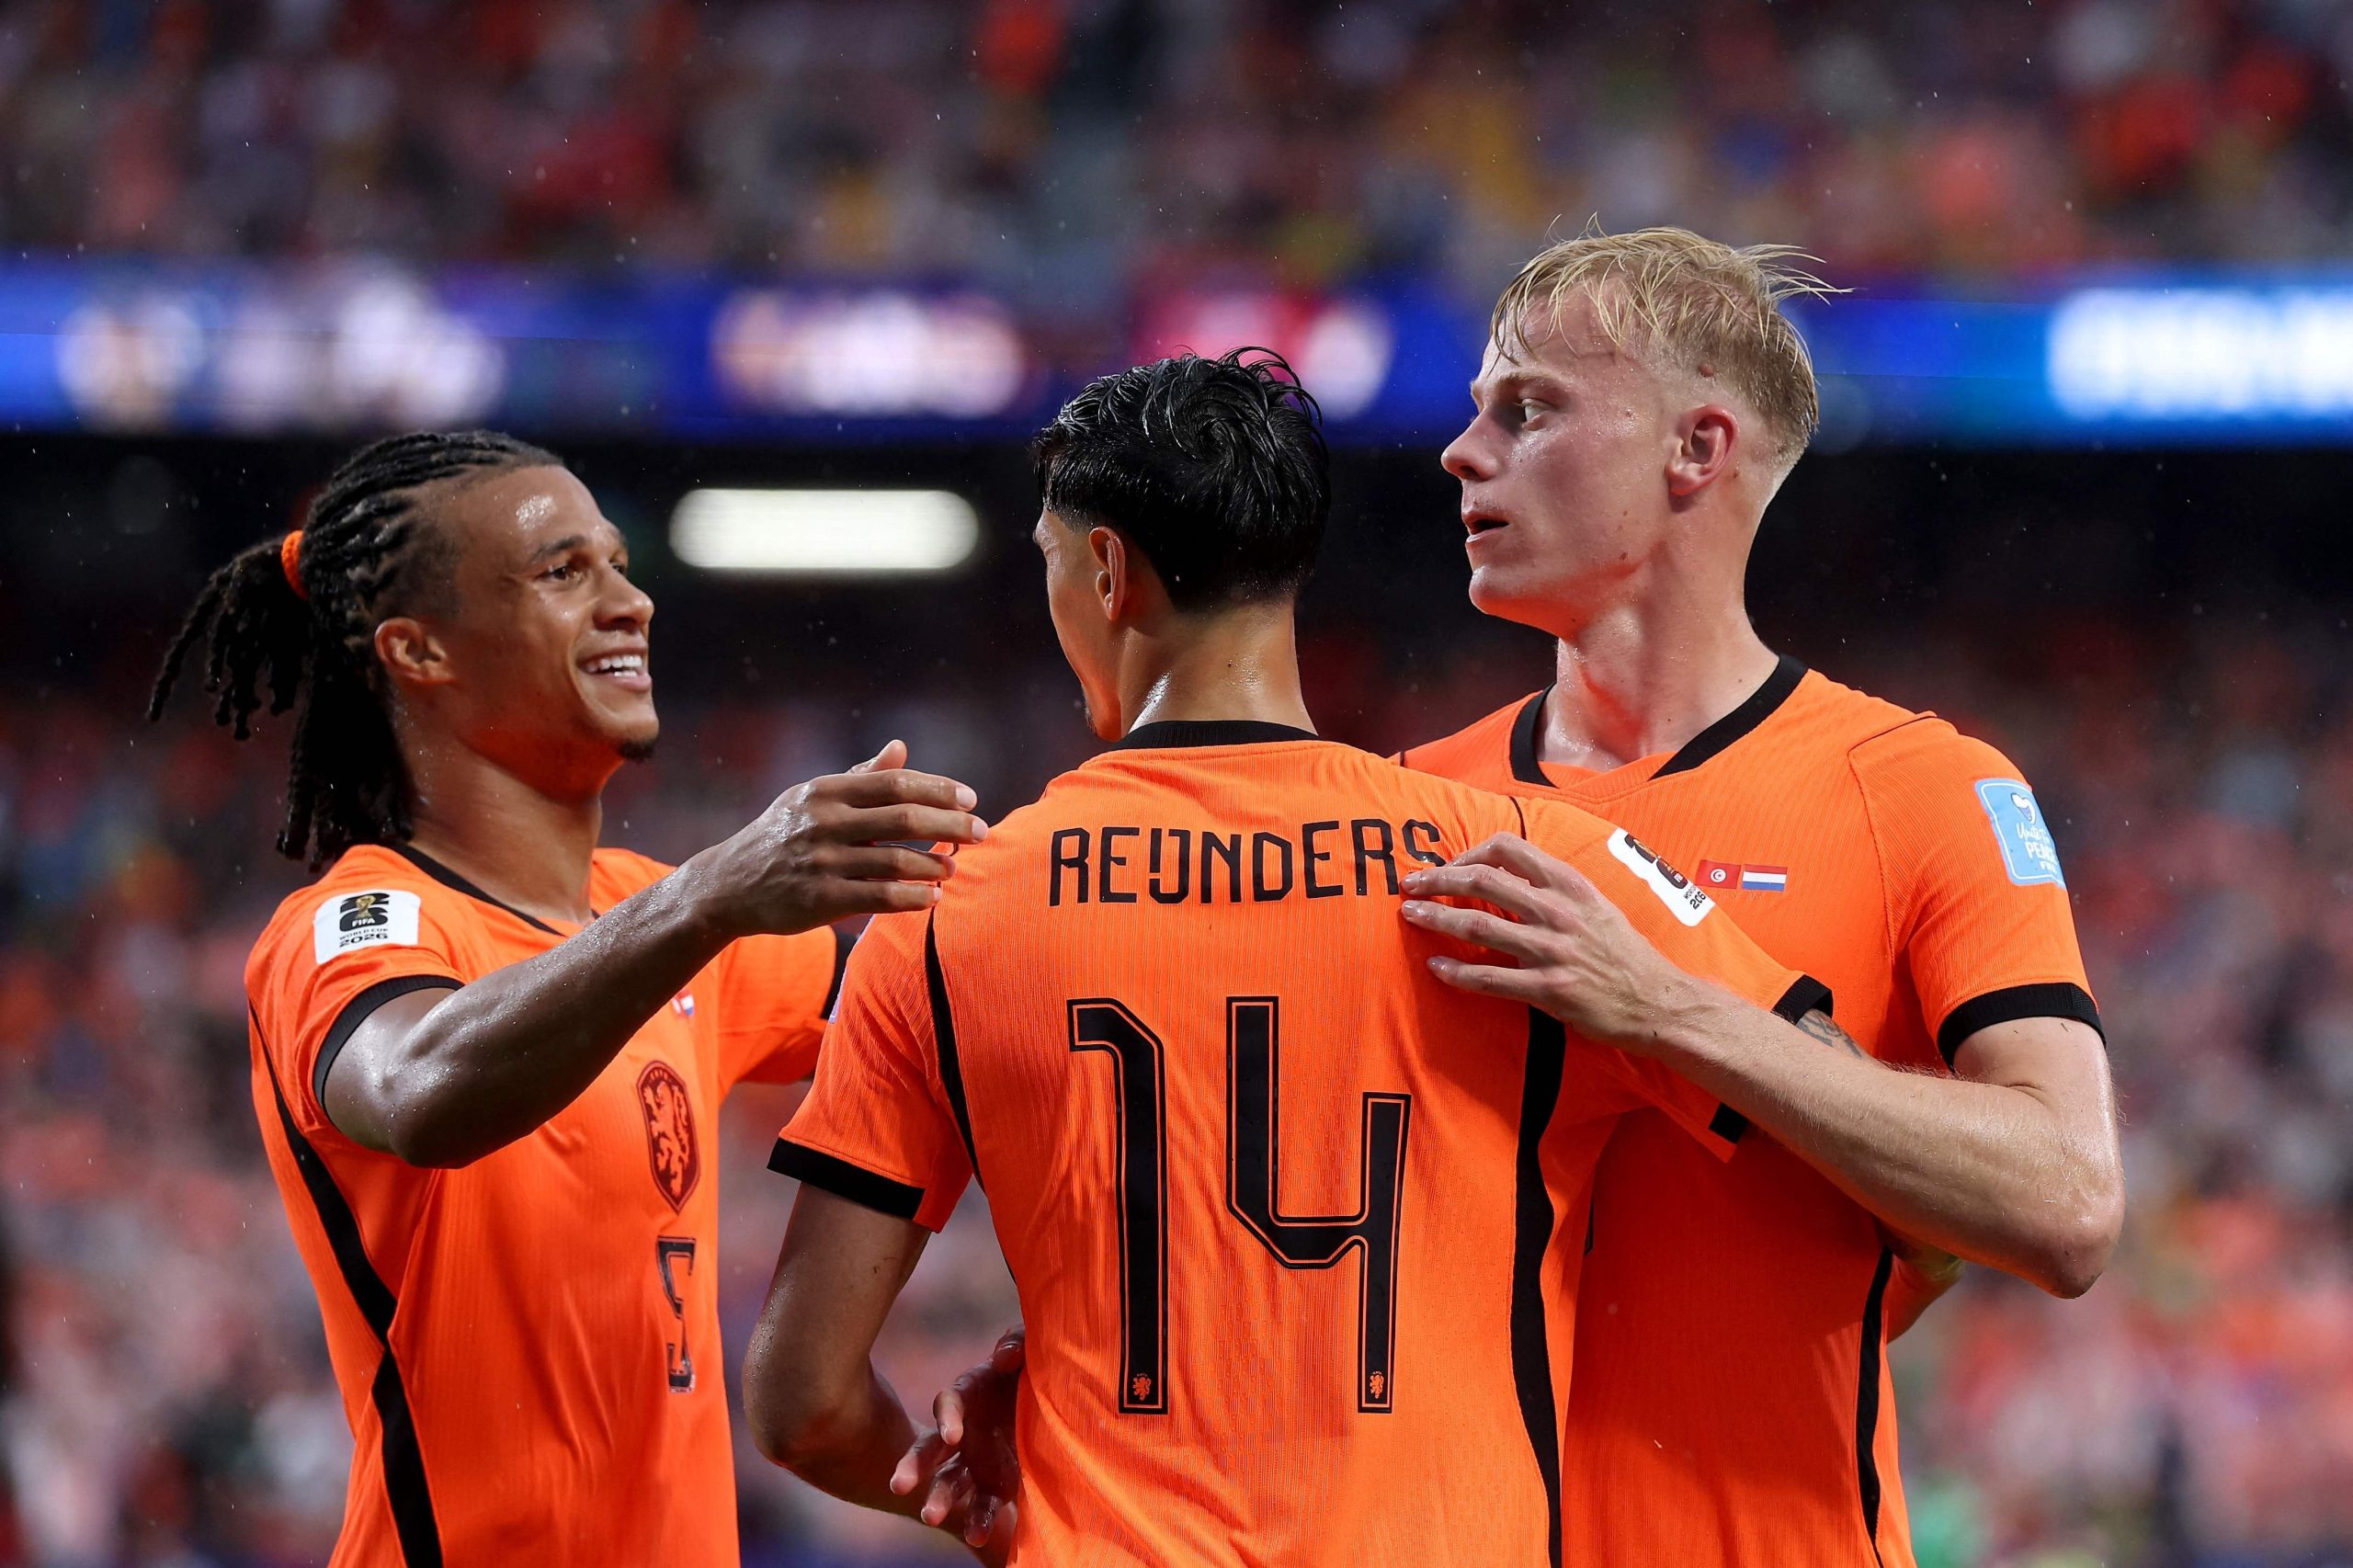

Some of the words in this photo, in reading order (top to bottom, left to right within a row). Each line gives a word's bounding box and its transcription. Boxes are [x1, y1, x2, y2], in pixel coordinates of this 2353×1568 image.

[352, 918, 375, 927] FIFA
[339, 928, 369, 940] WORLD
[339, 933, 388, 948] 2026
[1066, 995, 1412, 1415] 14
[655, 1235, 696, 1394] 5
